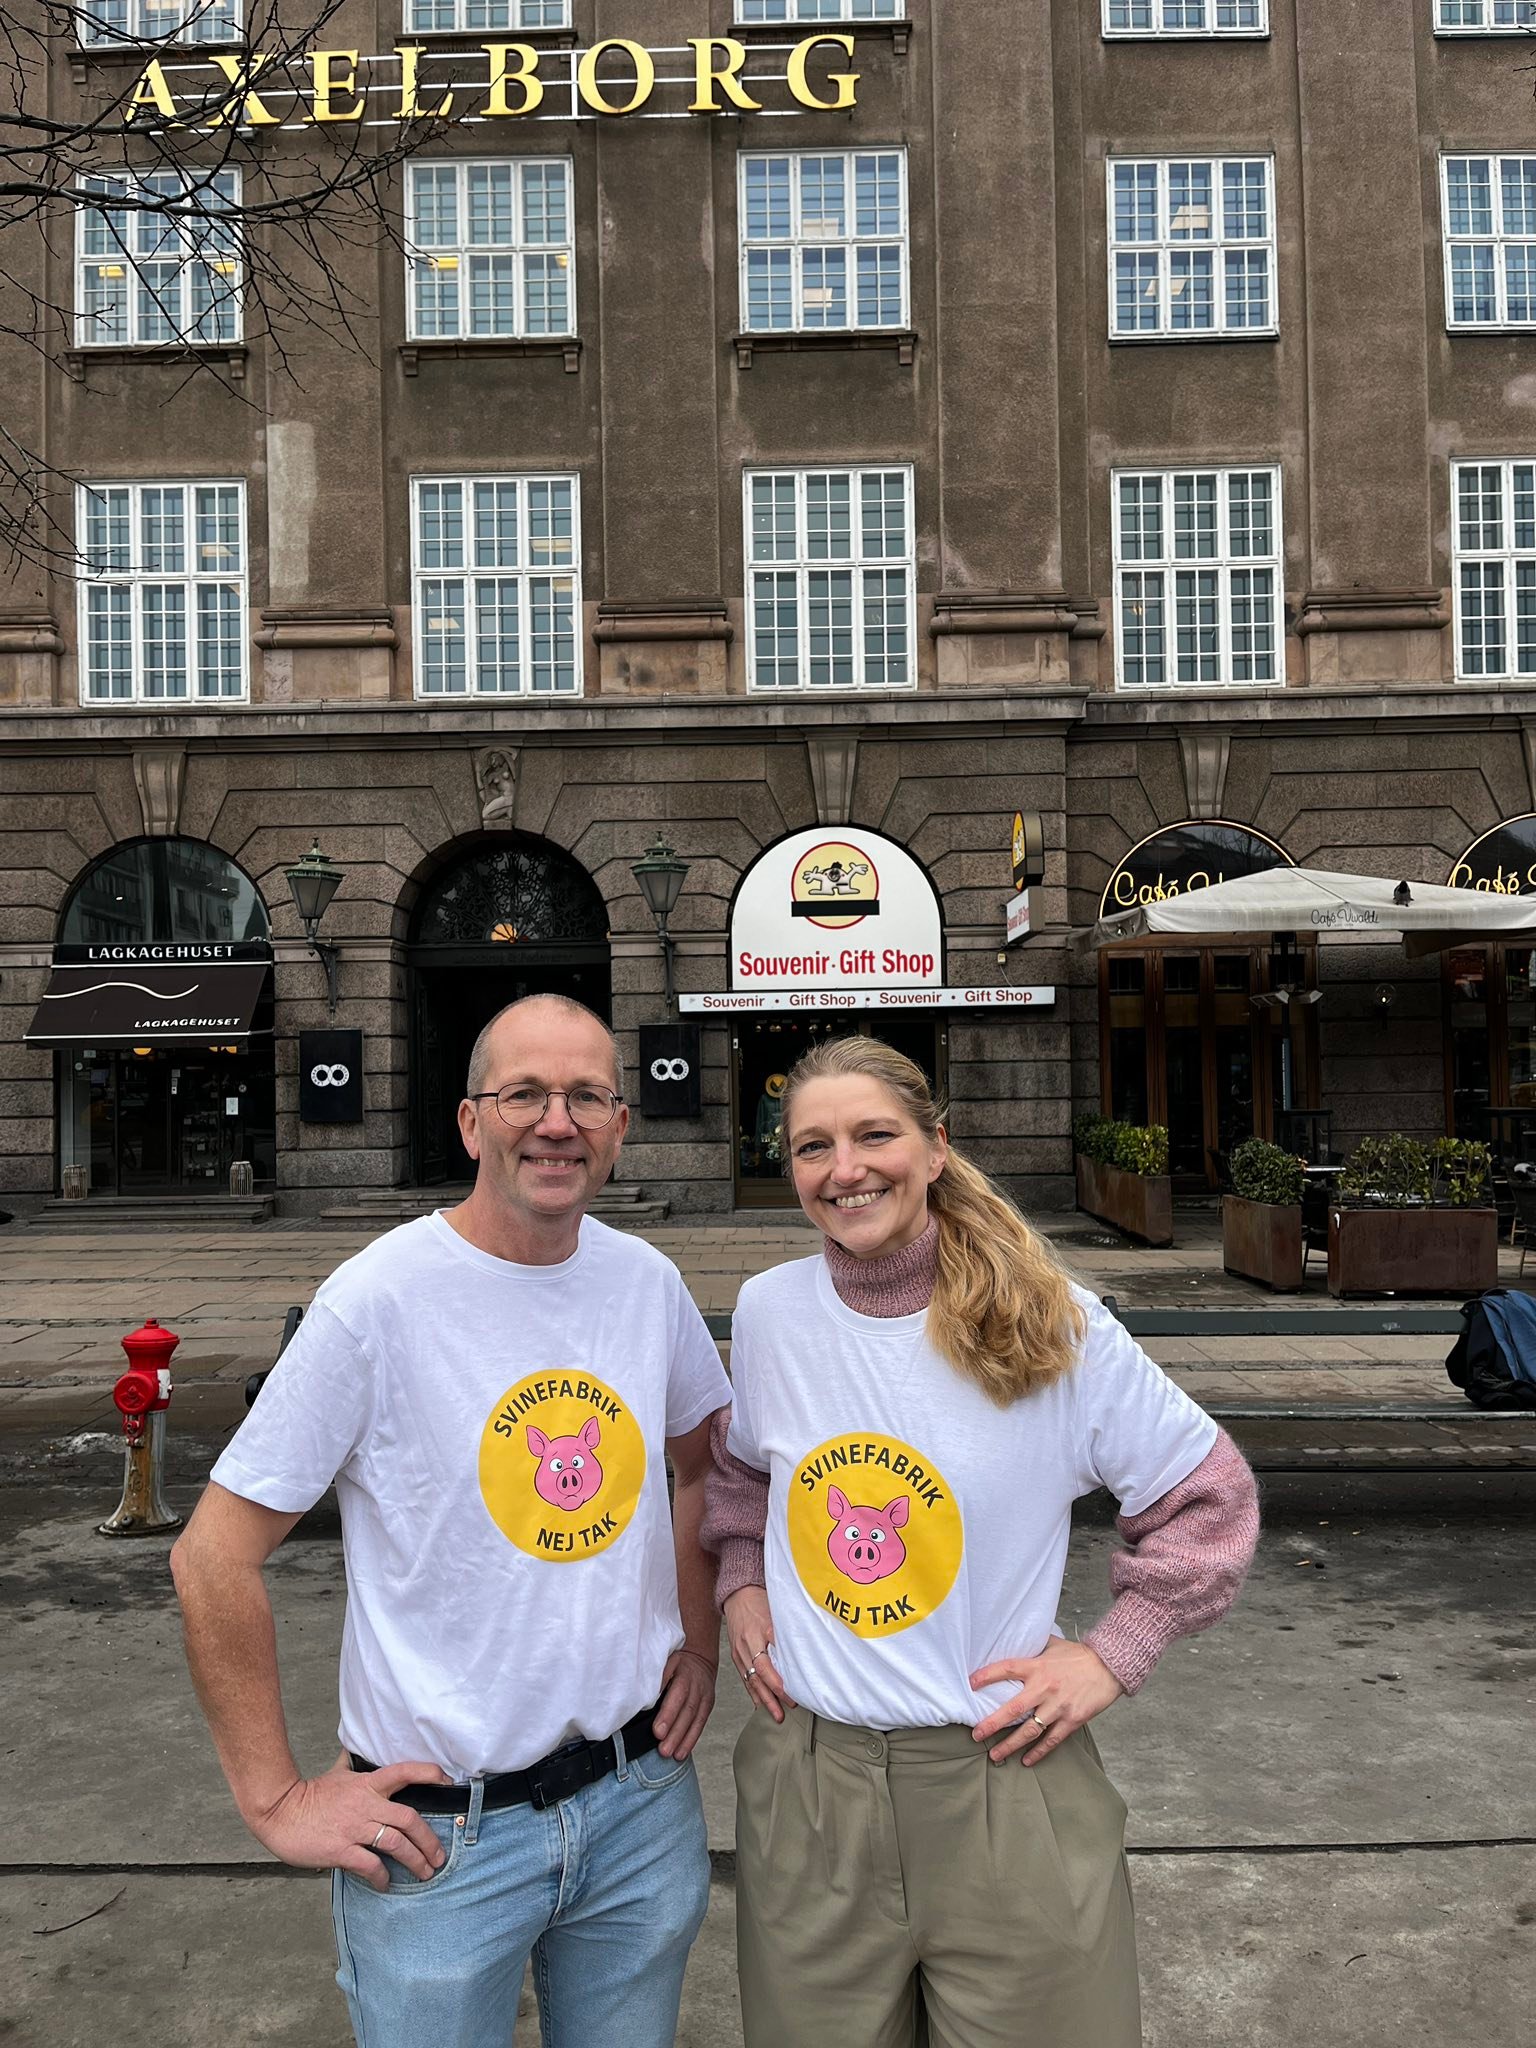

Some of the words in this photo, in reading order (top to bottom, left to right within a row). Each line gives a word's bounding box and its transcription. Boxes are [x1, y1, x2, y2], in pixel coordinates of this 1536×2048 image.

[124, 33, 861, 128] AXELBORG
[1311, 909, 1336, 927] Café
[88, 946, 234, 959] LAGKAGEHUSET
[739, 951, 830, 976] Souvenir
[840, 949, 875, 974] Gift
[882, 949, 934, 977] Shop
[703, 995, 765, 1008] Souvenir
[789, 994, 816, 1006] Gift
[819, 994, 856, 1008] Shop
[879, 991, 942, 1004] Souvenir
[964, 990, 991, 1003] Gift
[995, 990, 1033, 1004] Shop
[134, 1017, 240, 1029] LAGKAGEHUSET
[494, 1379, 622, 1438] SVINEFABRIK
[800, 1443, 945, 1509] SVINEFABRIK
[536, 1527, 574, 1552] NEJ
[578, 1511, 618, 1547] TAK
[825, 1590, 861, 1626] NEJ
[866, 1594, 916, 1626] TAK
